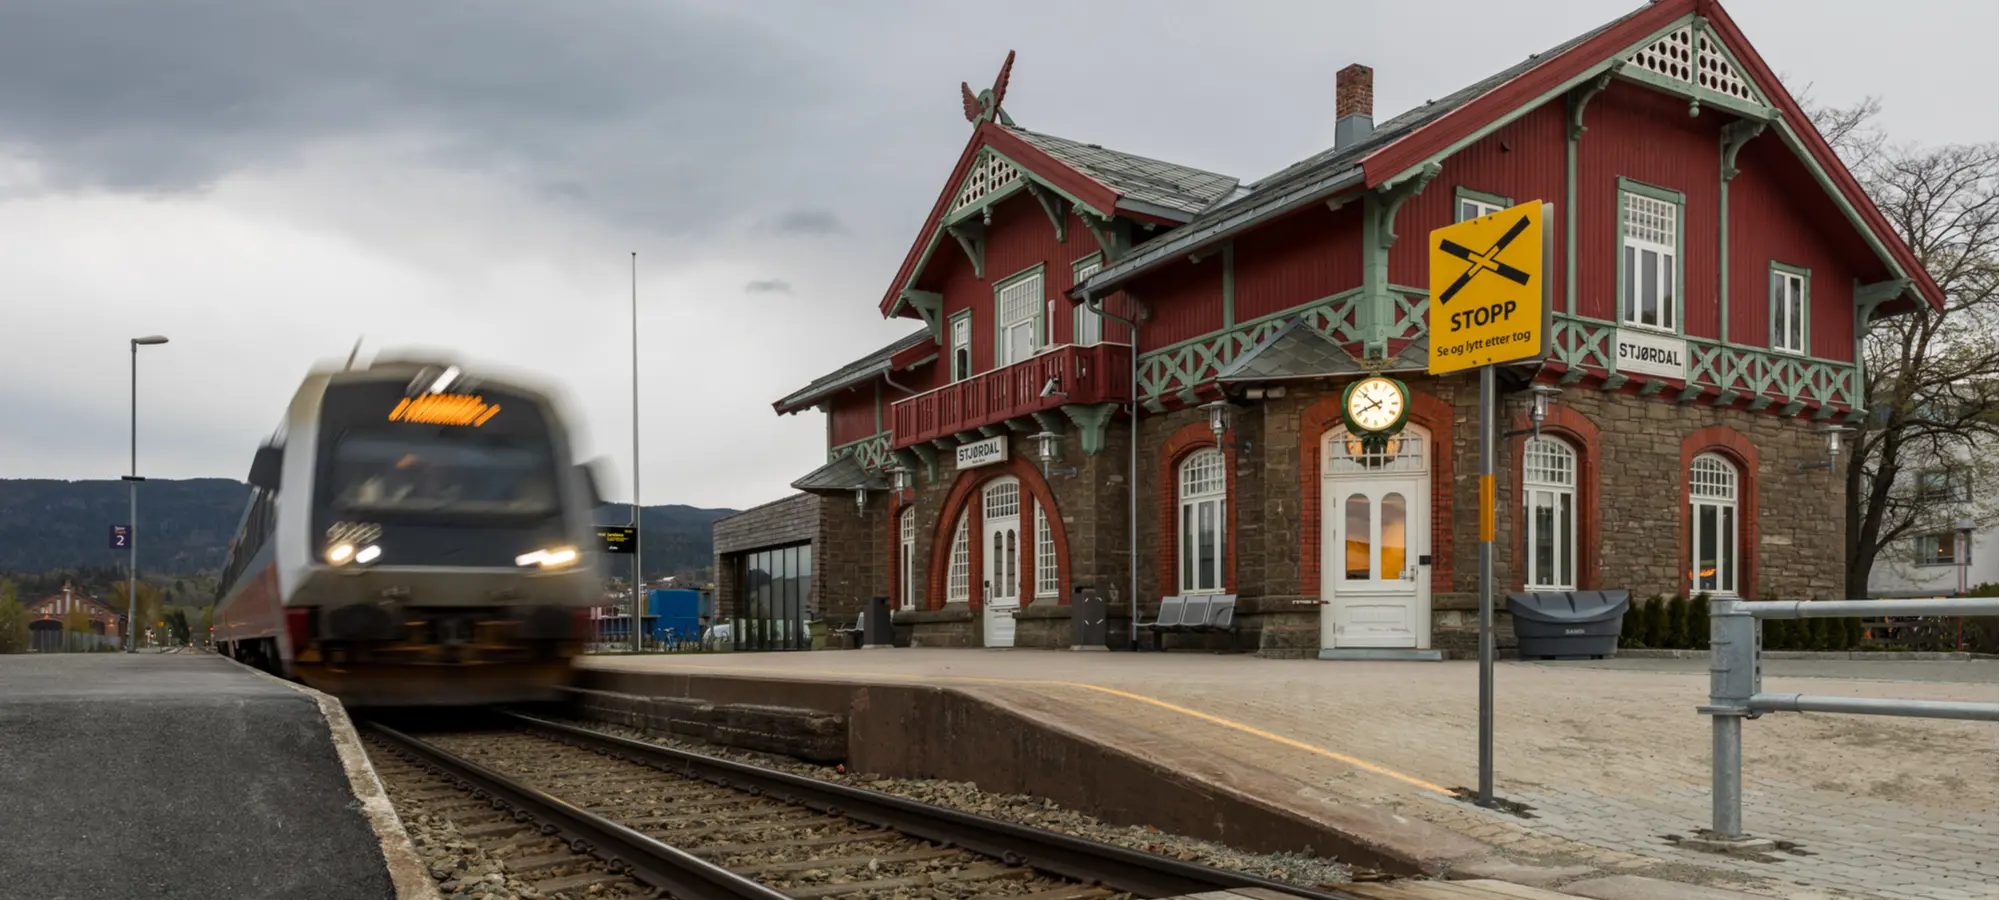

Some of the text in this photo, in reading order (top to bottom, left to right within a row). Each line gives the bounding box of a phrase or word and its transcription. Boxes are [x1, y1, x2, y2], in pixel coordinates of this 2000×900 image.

[1451, 300, 1516, 332] STOPP
[1437, 330, 1531, 357] Se og lytt etter tog
[1619, 342, 1682, 366] STJØRDAL
[959, 441, 999, 461] STJØRDAL
[116, 535, 125, 546] 2
